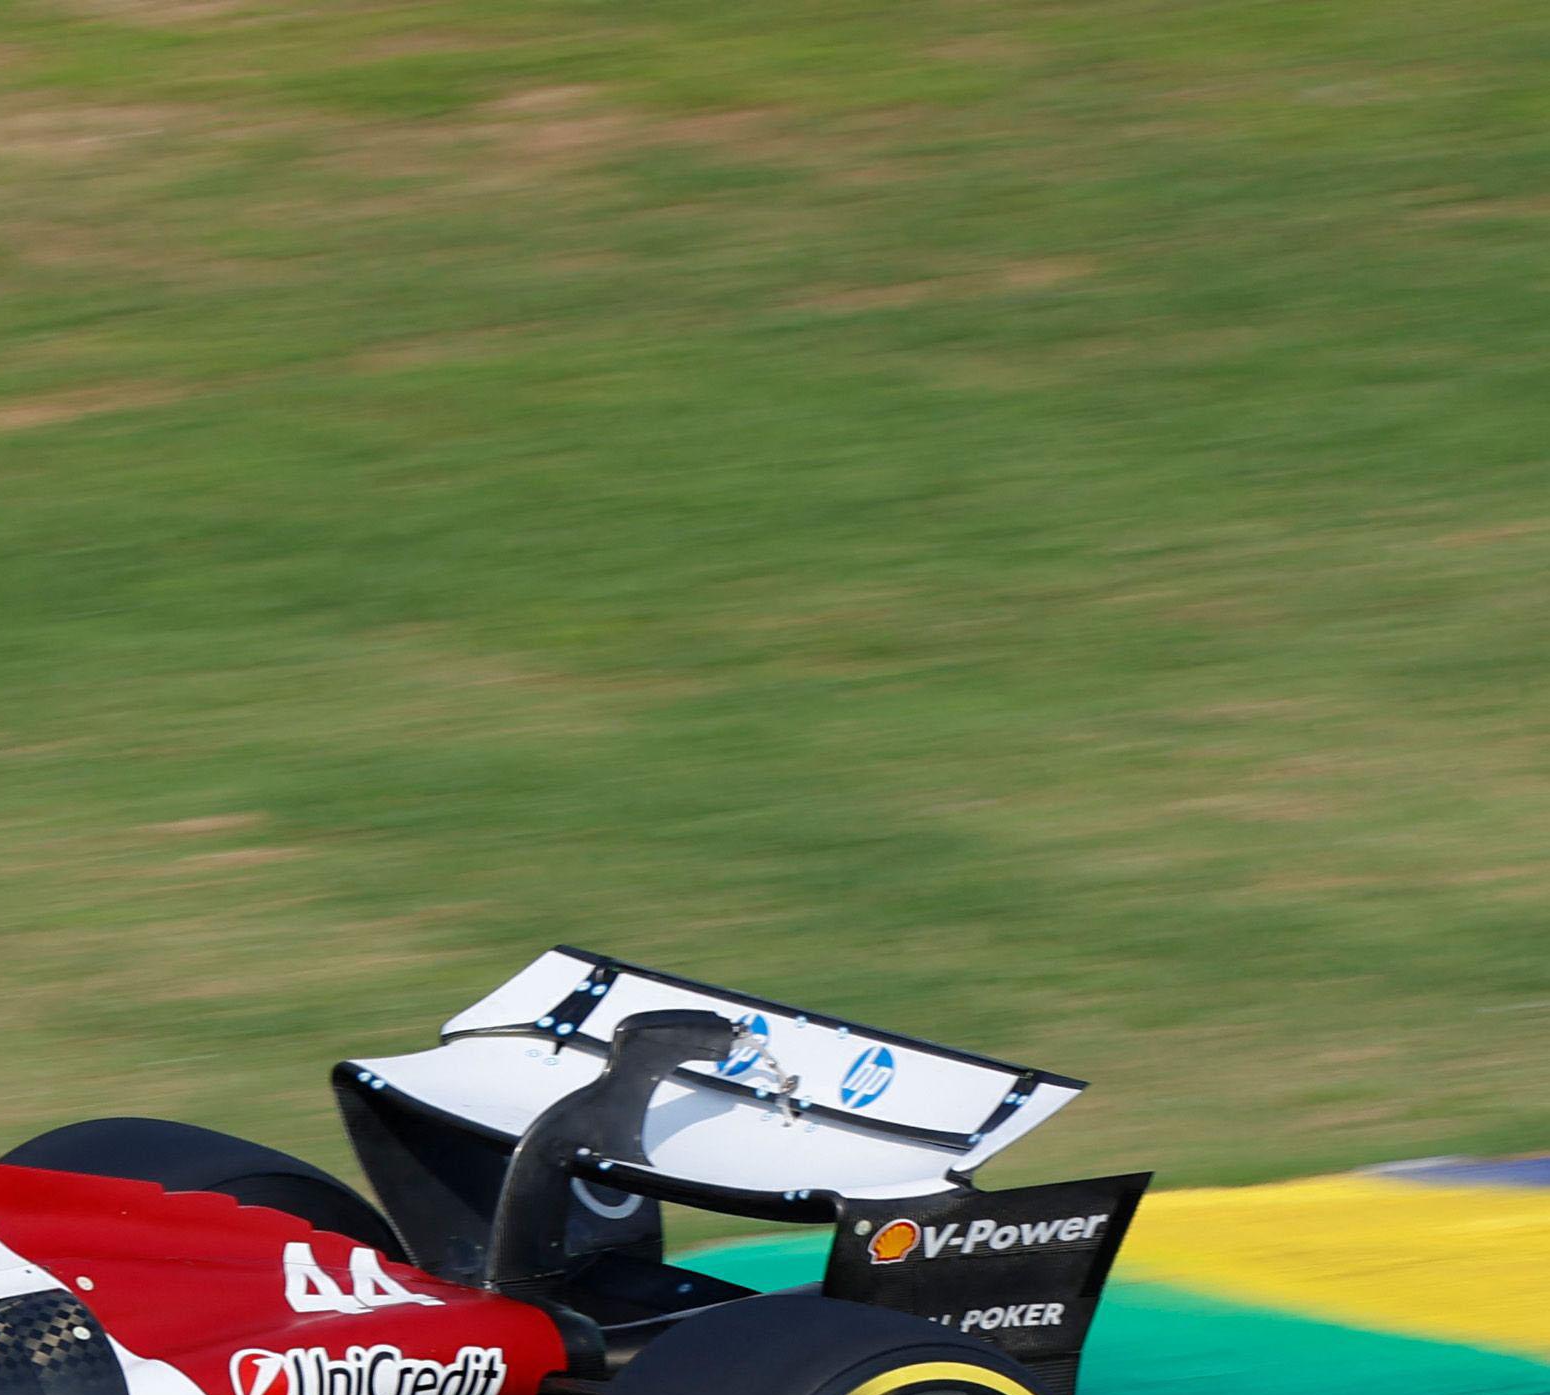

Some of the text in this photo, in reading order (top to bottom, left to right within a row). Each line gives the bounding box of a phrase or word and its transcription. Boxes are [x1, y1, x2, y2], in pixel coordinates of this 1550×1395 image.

[844, 1047, 894, 1108] hp
[923, 1214, 1110, 1259] V-Power
[283, 1242, 447, 1314] 44
[960, 1302, 1066, 1334] POKER
